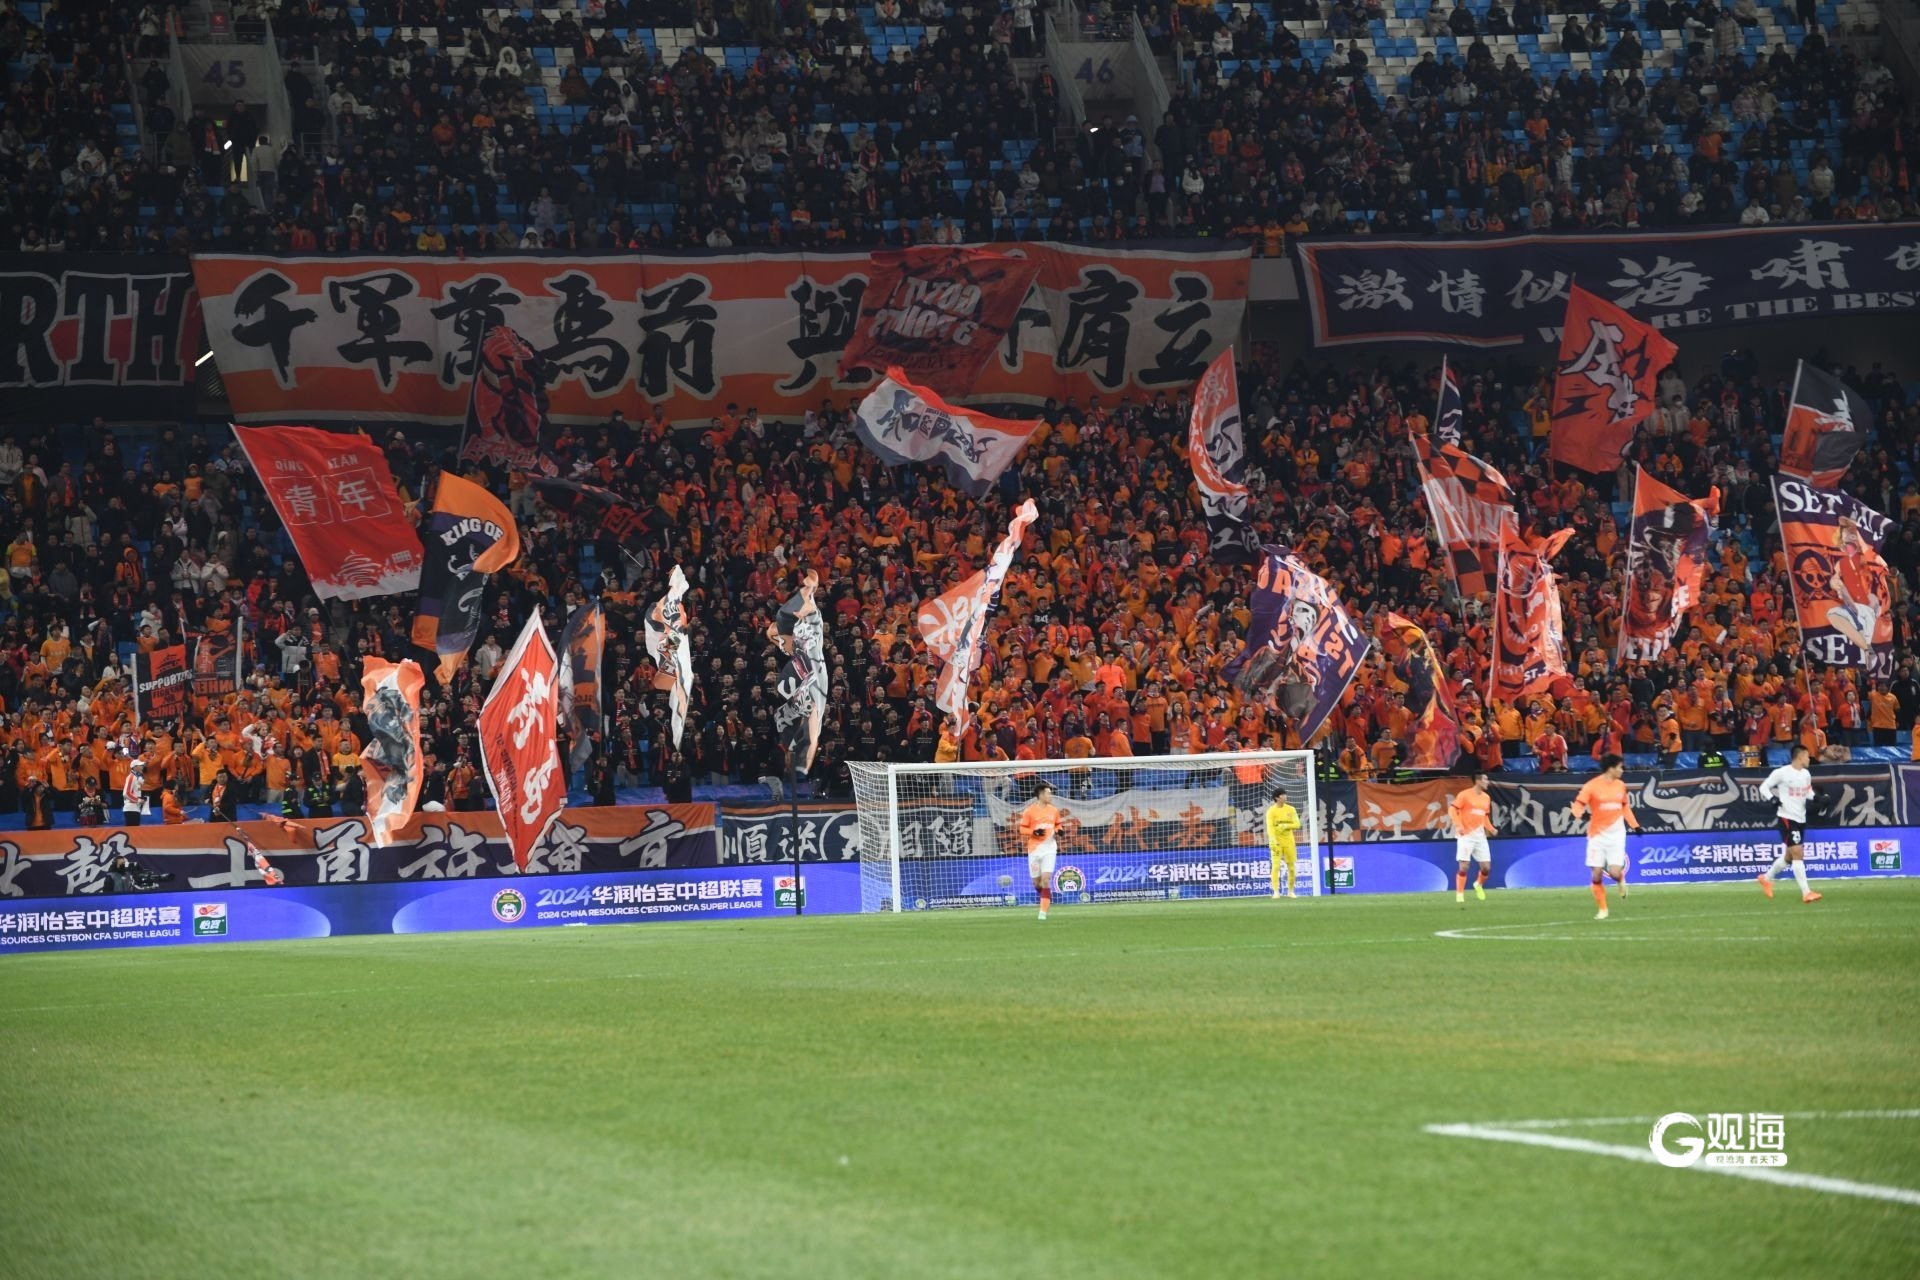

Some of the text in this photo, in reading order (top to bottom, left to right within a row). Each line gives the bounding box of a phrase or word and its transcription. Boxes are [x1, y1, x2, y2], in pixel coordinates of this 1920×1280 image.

[204, 58, 246, 89] 45
[1073, 56, 1116, 83] 46
[1725, 296, 1819, 321] THE
[1832, 290, 1920, 310] BES
[285, 479, 374, 517] 青年
[1778, 481, 1843, 515] SET
[440, 518, 504, 546] KING OF
[1663, 866, 1688, 876] CHINA
[1689, 865, 1738, 875] RESOURCES
[1825, 862, 1858, 871] LEAGUE
[560, 909, 587, 919] CHINA
[588, 907, 640, 917] RESOURCES
[640, 904, 682, 914] C'ESTBON
[682, 903, 700, 912] CFA
[701, 902, 729, 911] SUPER
[729, 900, 763, 910] LEAGUE
[47, 932, 92, 943] C'ESTBON
[93, 931, 112, 941] CFA
[112, 930, 144, 940] SUPER
[144, 928, 181, 939] LEAGUE
